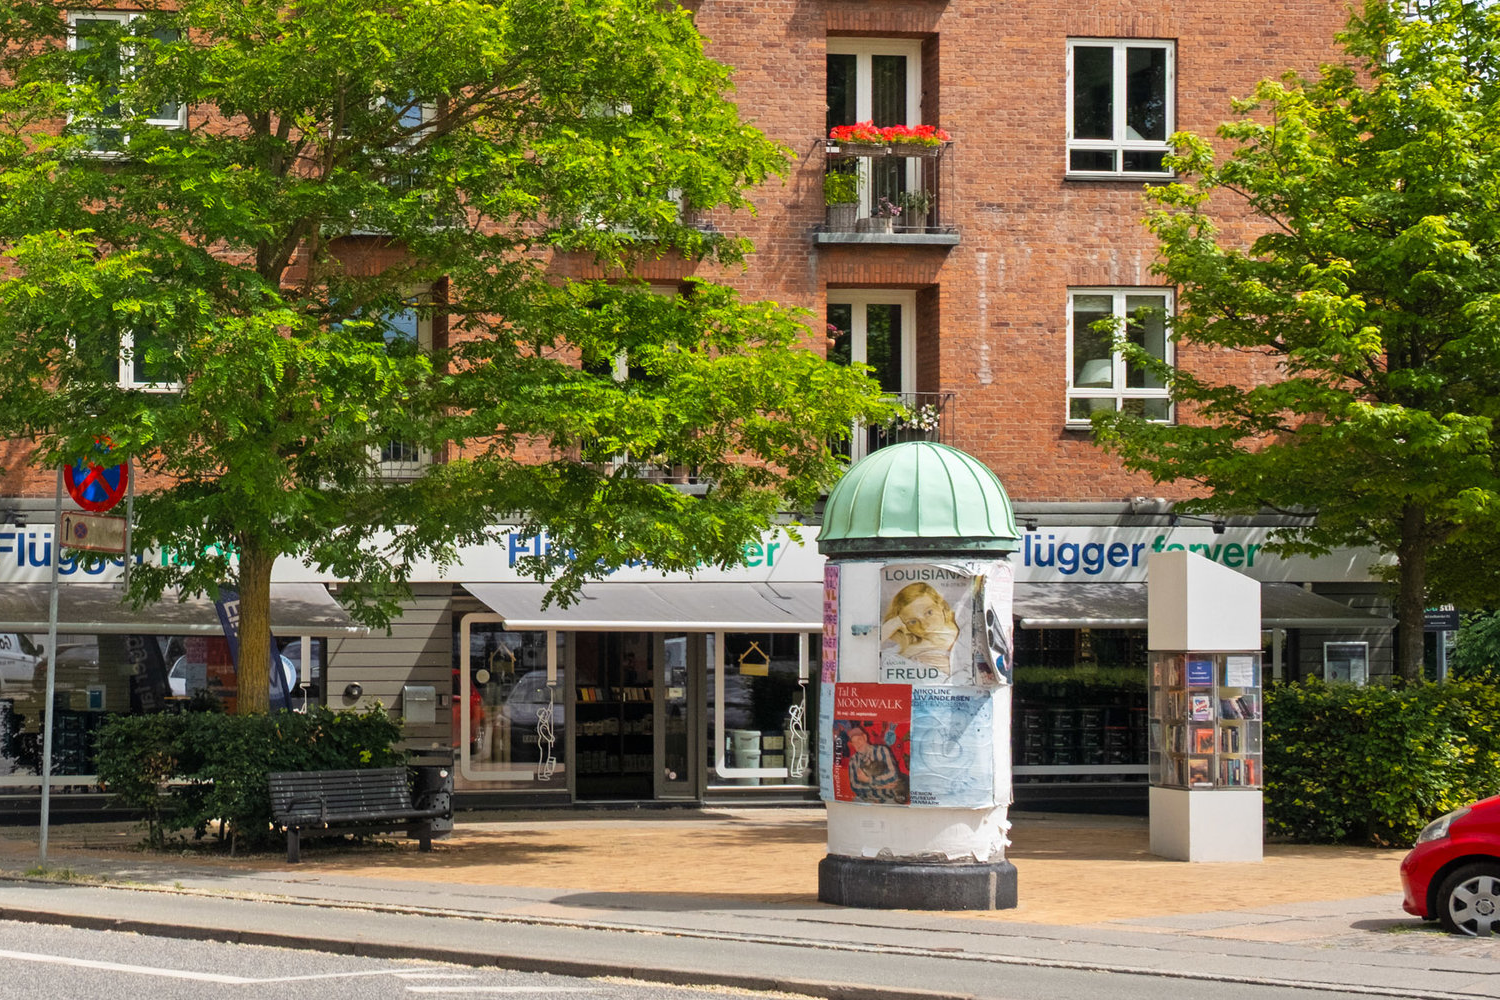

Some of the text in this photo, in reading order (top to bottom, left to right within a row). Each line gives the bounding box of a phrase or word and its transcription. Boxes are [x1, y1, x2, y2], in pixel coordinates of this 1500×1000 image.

[1021, 534, 1145, 575] lügger
[886, 667, 939, 680] FREUD
[837, 686, 858, 697] Tal R
[837, 697, 903, 710] MOONWALK
